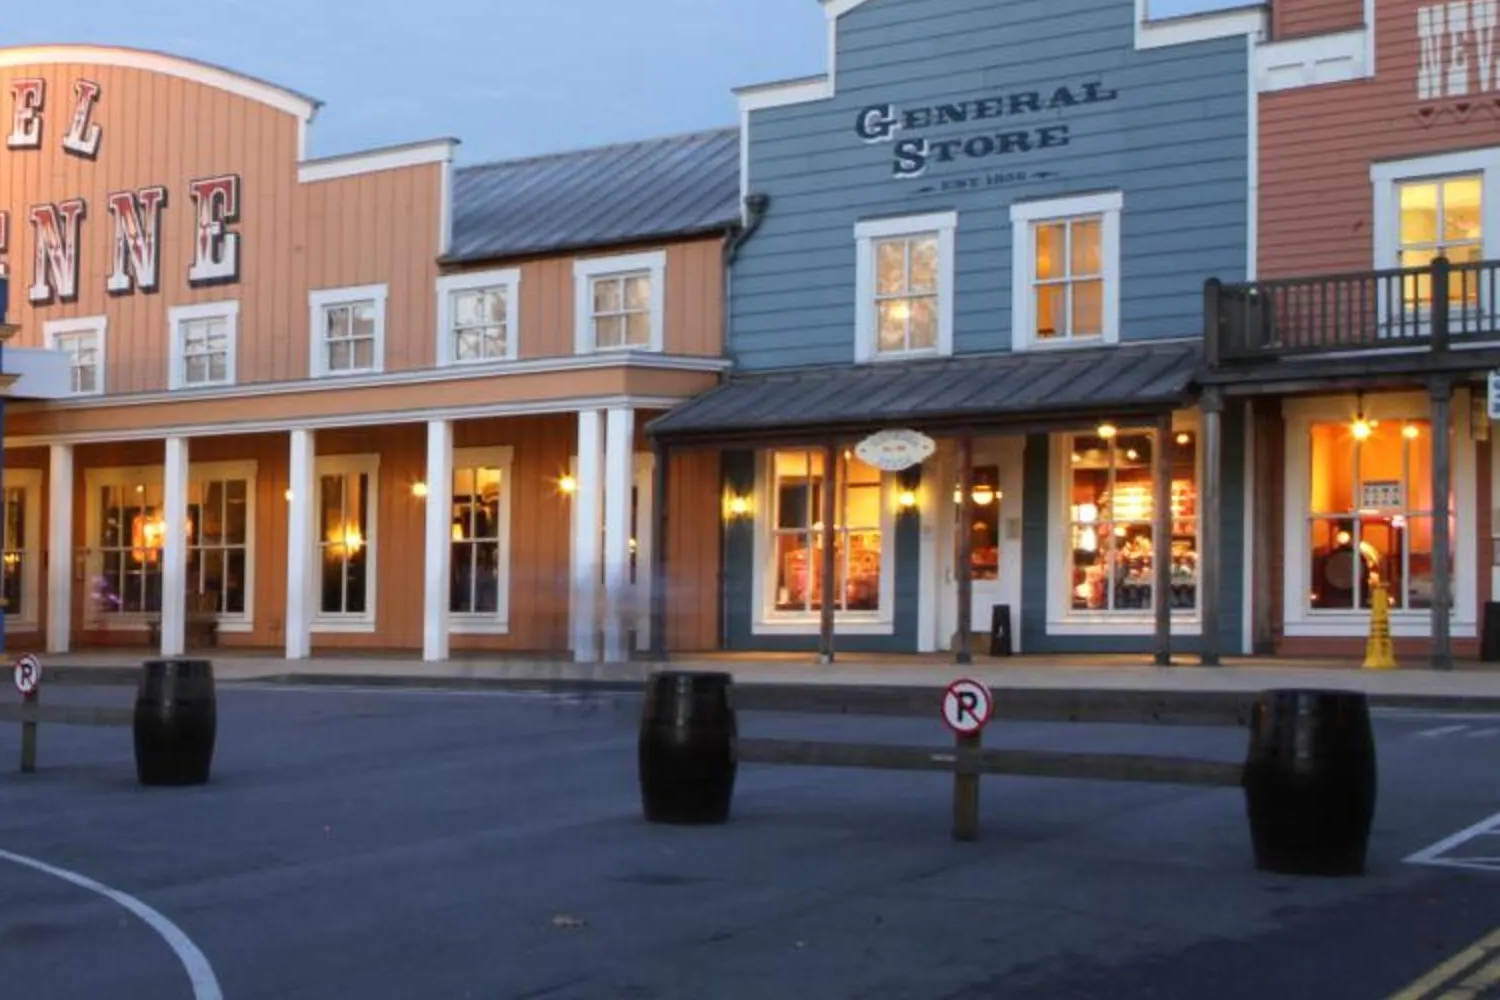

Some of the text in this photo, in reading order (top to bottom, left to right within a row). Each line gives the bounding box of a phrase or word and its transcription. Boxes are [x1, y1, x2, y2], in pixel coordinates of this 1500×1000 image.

[855, 81, 1119, 143] GENERAL
[892, 124, 1071, 179] STORE
[957, 691, 977, 723] P
